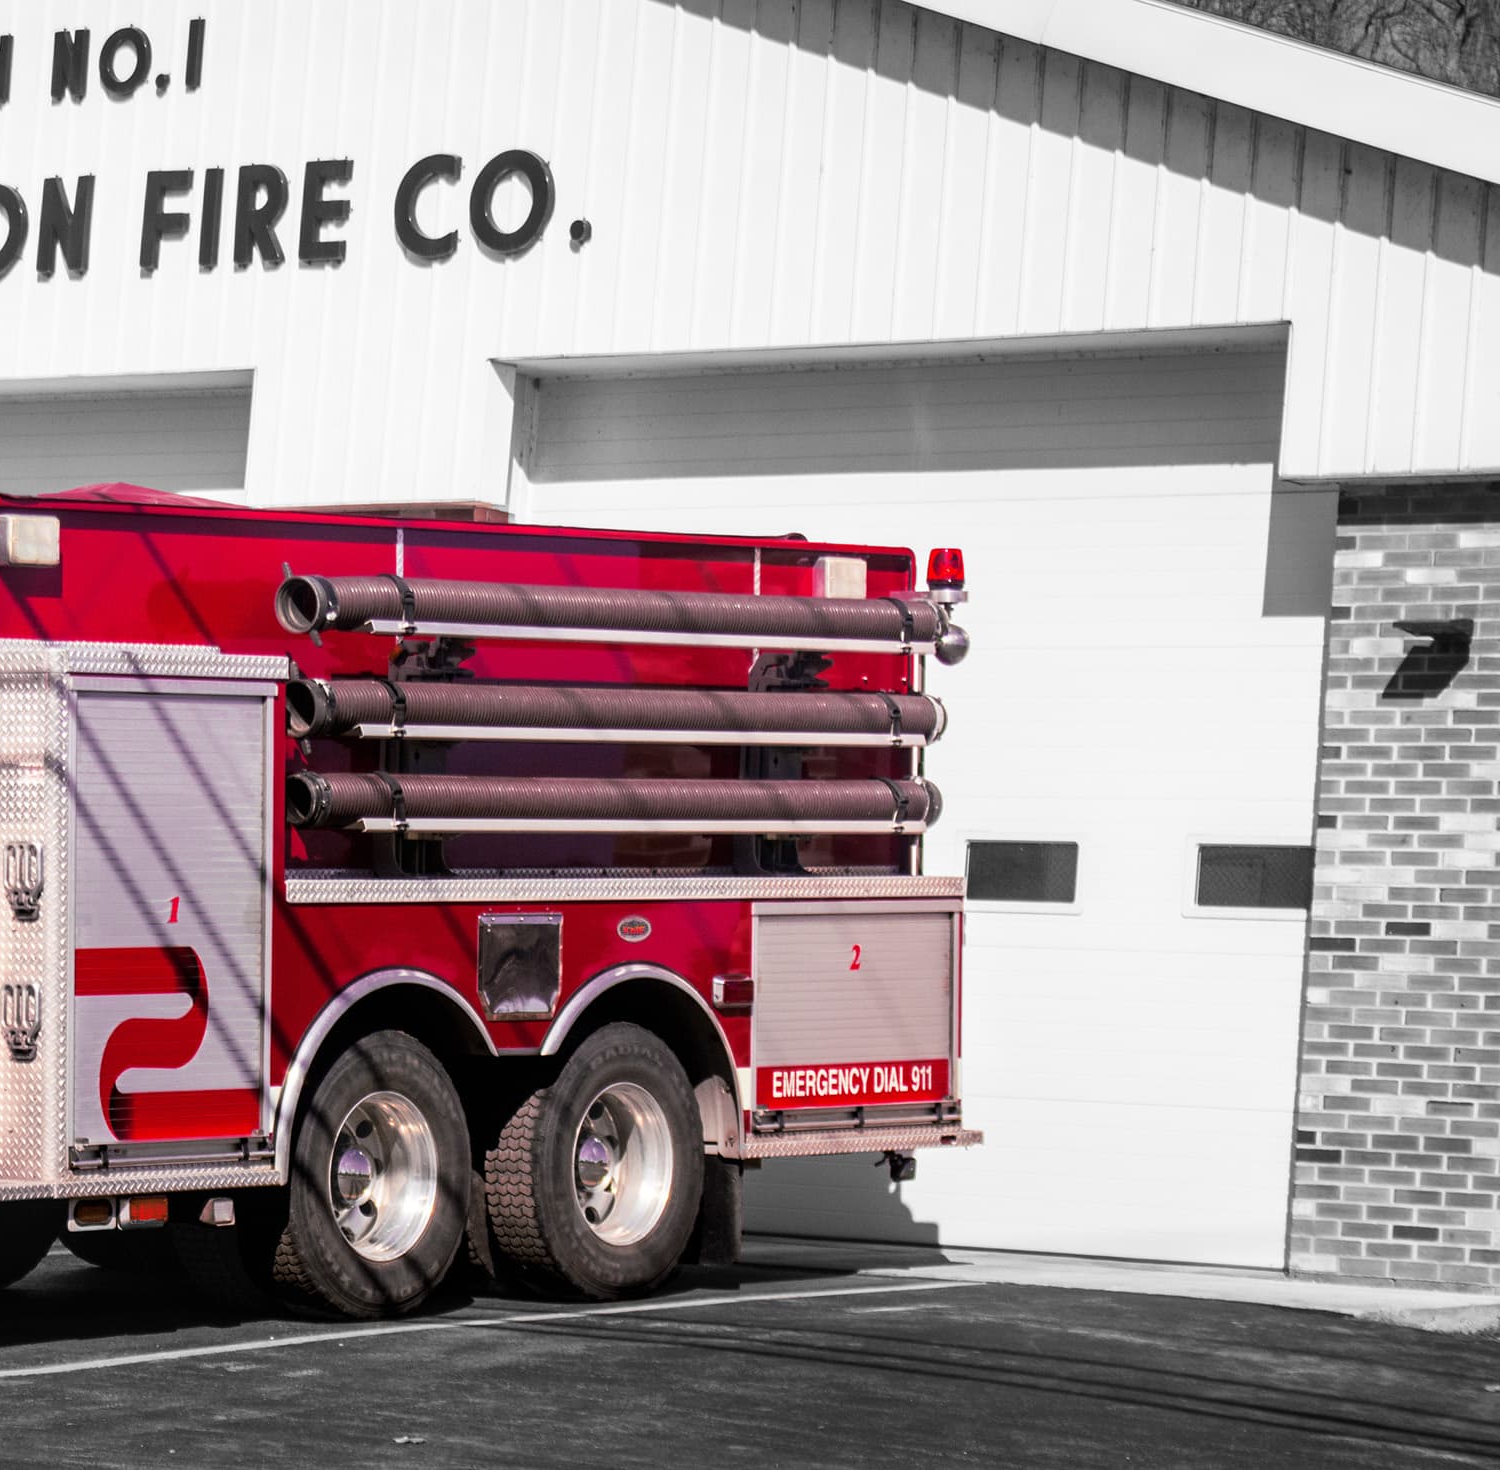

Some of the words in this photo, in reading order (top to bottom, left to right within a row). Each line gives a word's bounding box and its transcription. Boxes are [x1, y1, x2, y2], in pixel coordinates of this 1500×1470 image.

[139, 158, 354, 273] FIRE
[394, 150, 593, 260] CO.
[167, 896, 180, 923] 1
[849, 944, 862, 971] 2
[772, 1068, 870, 1098] EMERGENCY
[873, 1066, 909, 1094] DIAL
[911, 1065, 933, 1091] 911
